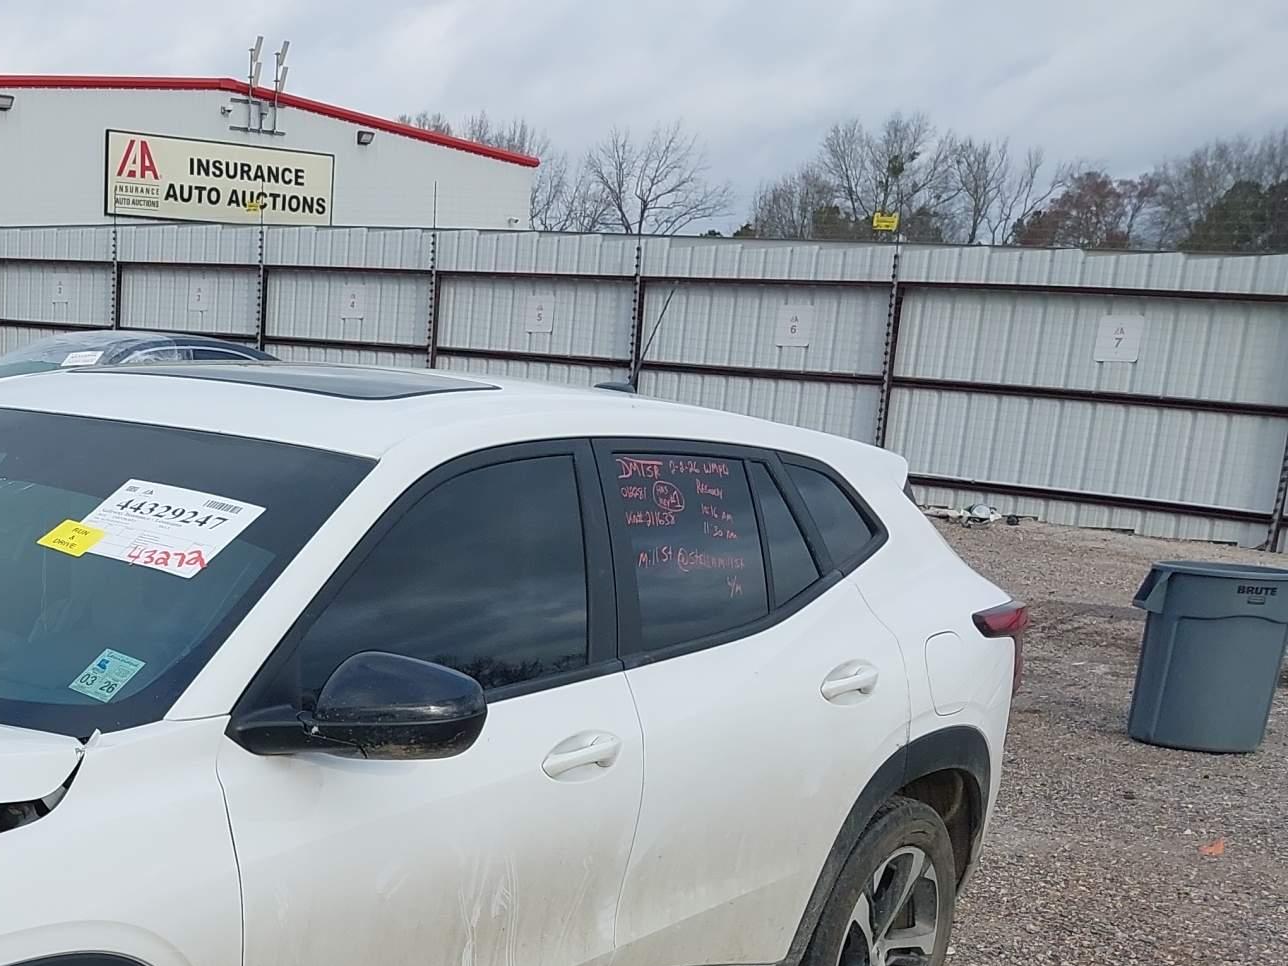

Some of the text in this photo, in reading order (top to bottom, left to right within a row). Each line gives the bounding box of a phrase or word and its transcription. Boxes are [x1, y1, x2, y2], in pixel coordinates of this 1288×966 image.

[189, 157, 305, 186] INSURANCE
[114, 184, 160, 196] INSURANCE
[115, 197, 160, 209] AUTO AUCTIONS
[164, 183, 221, 206] AUTO
[227, 189, 326, 215] AUCTIONS
[536, 313, 543, 321] 5
[790, 325, 797, 334] 6
[1114, 337, 1123, 348] 7
[116, 498, 229, 530] 44329247
[72, 527, 90, 536] RUN
[52, 538, 77, 549] DRIVE
[1237, 585, 1278, 596] BRUTE
[79, 673, 98, 686] 03
[99, 680, 118, 694] 26
